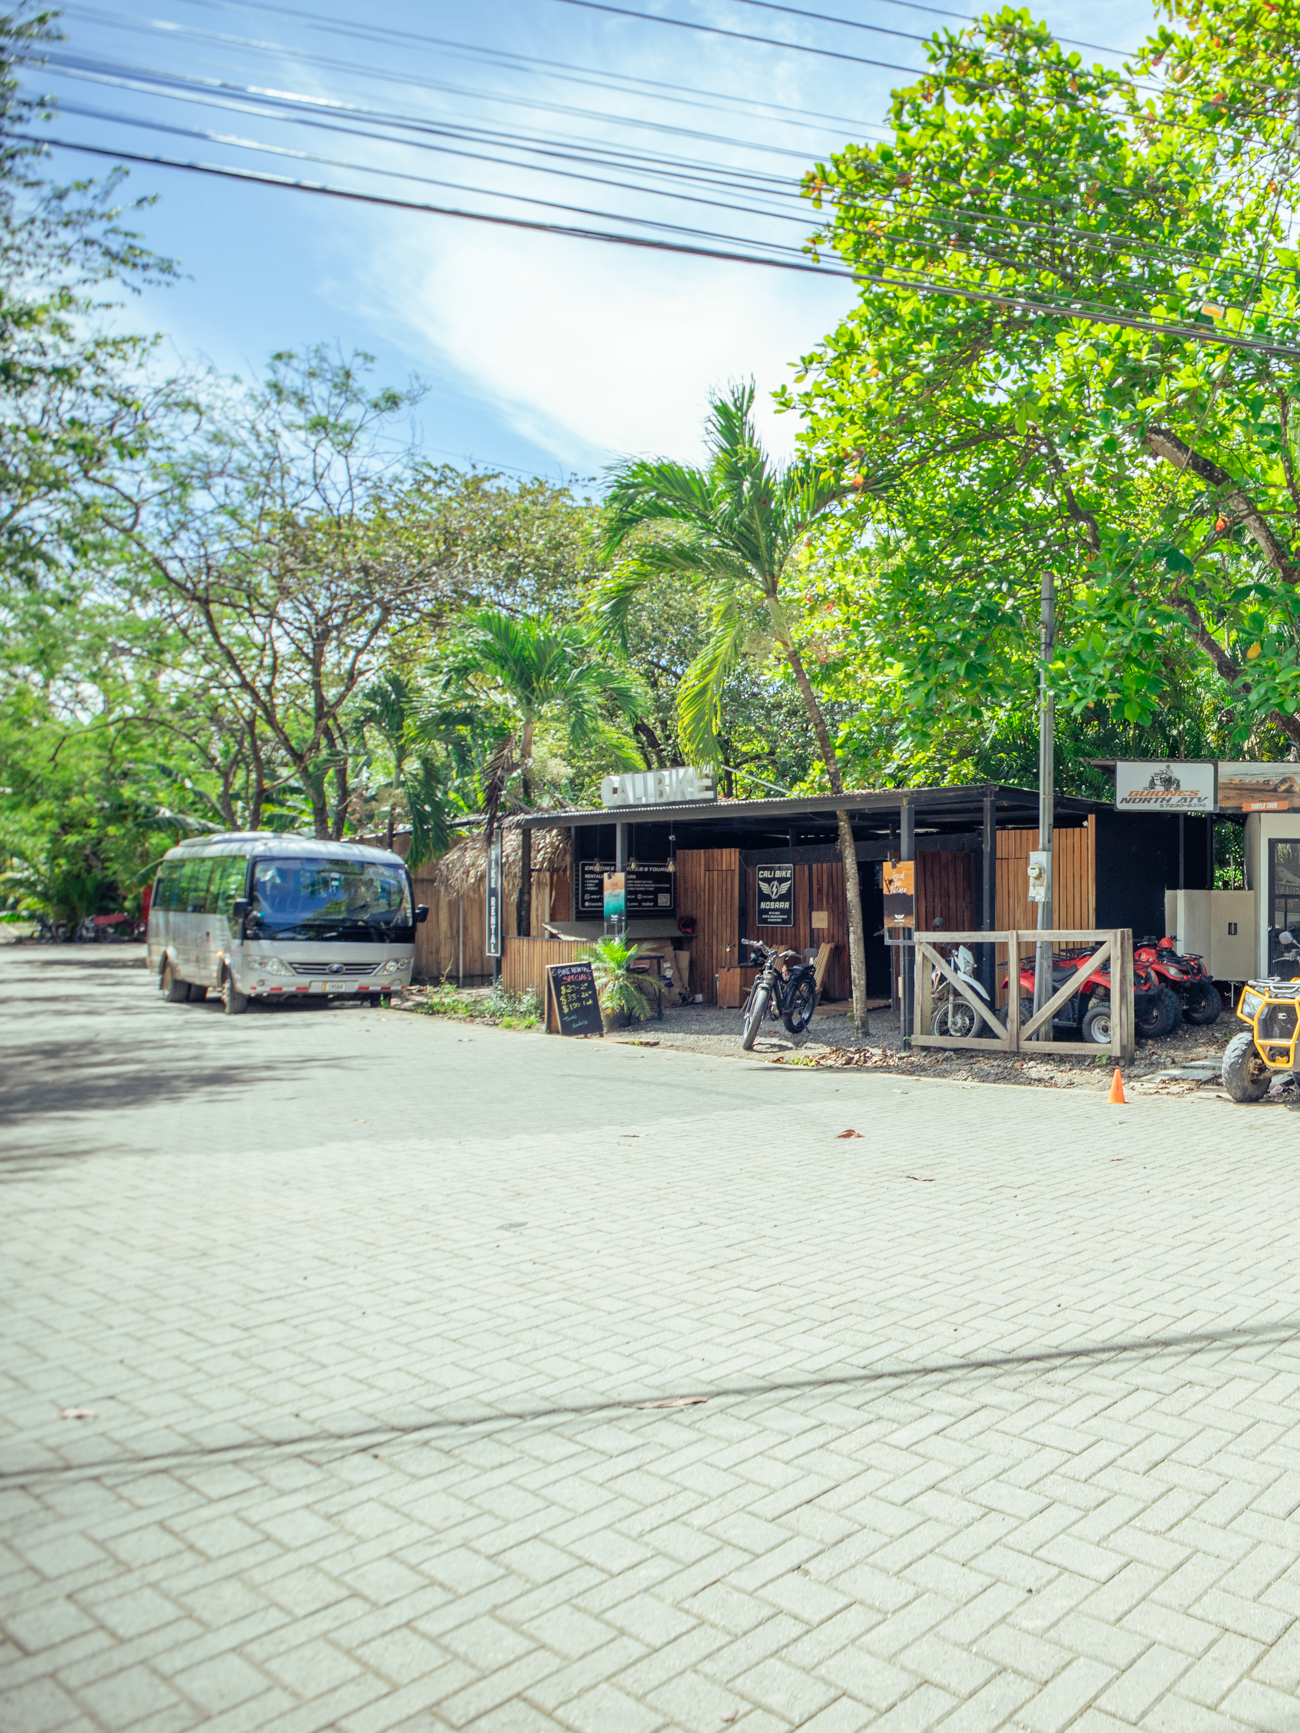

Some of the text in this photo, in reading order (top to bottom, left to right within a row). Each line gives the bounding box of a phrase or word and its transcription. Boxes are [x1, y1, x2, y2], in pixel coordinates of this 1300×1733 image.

[601, 764, 714, 806] CALI BIKE
[1119, 796, 1172, 804] NORTH
[758, 870, 791, 878] CALI BIKE
[760, 901, 790, 909] NOSARA
